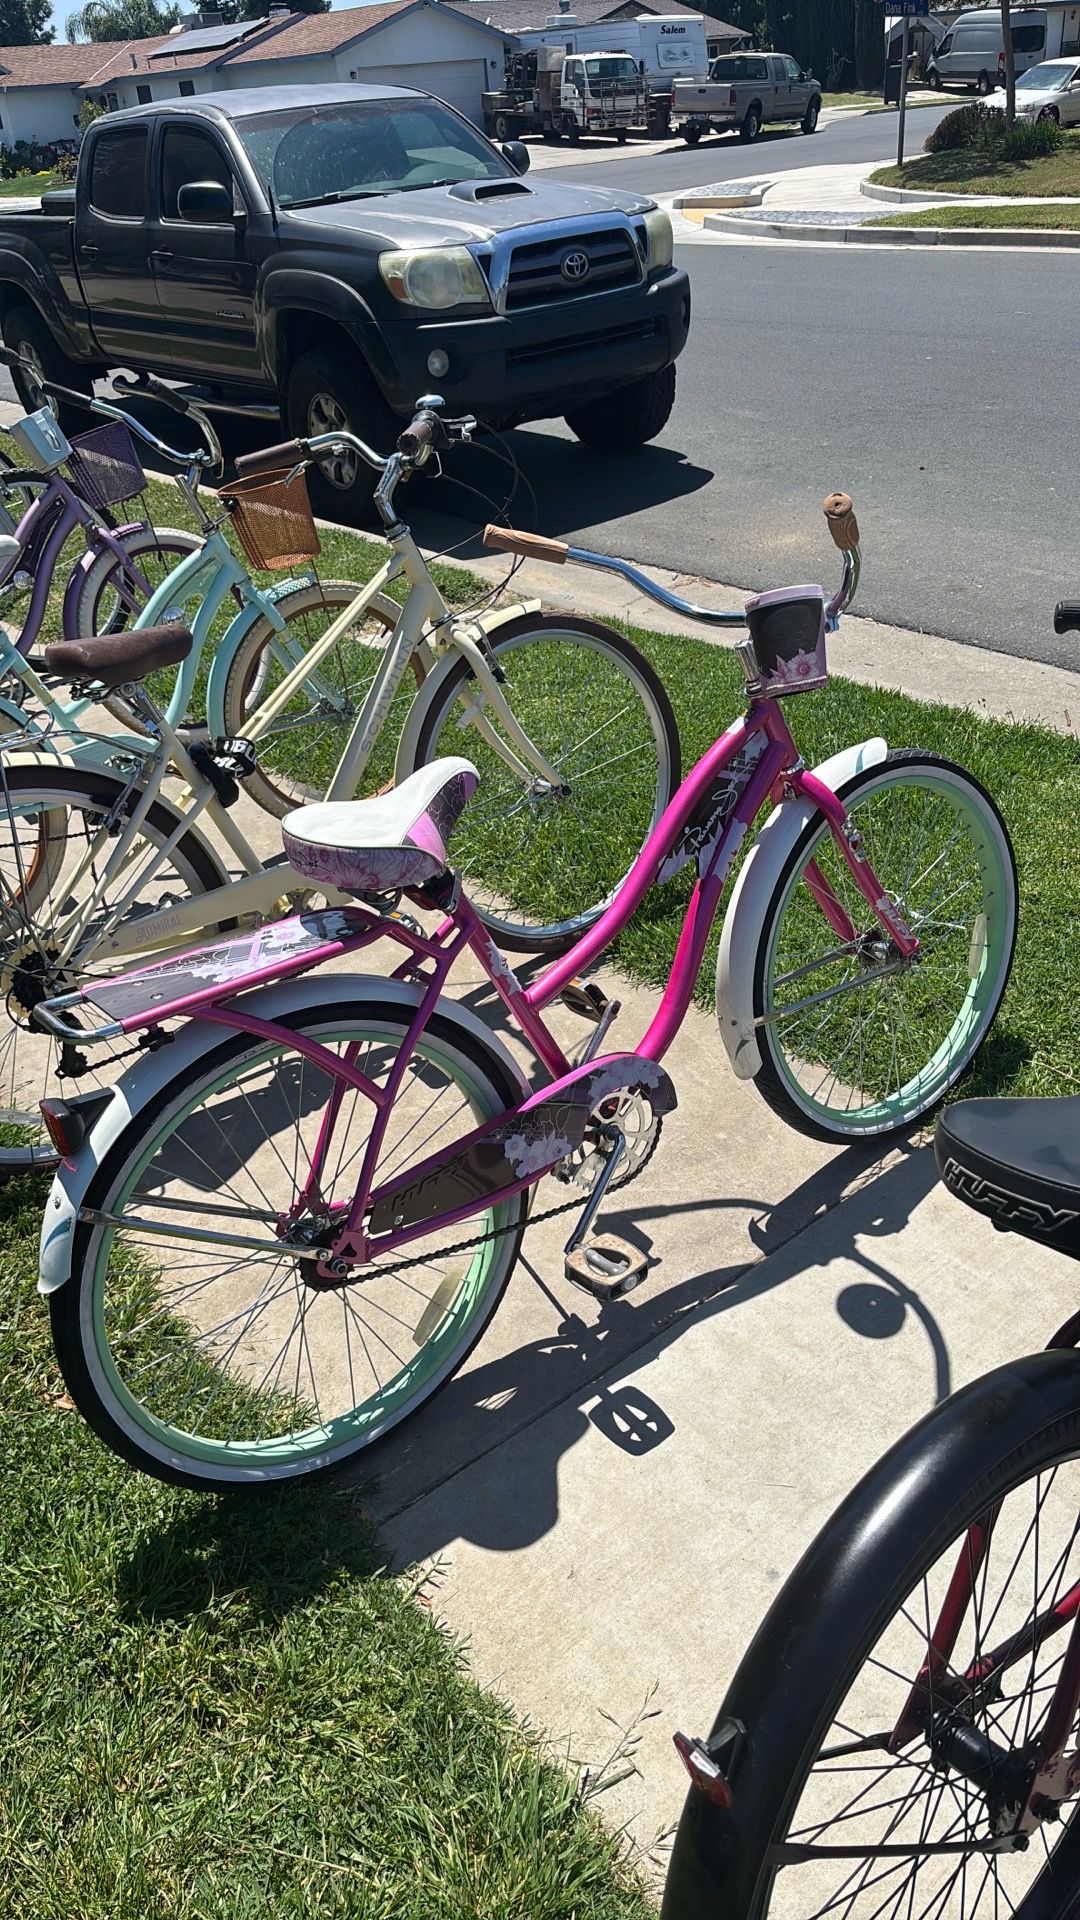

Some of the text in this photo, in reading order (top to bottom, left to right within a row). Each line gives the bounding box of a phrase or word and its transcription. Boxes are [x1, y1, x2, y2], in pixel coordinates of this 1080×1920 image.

[660, 25, 686, 34] Salem
[361, 637, 414, 753] SCHWINN
[942, 1156, 1080, 1232] HUFFY
